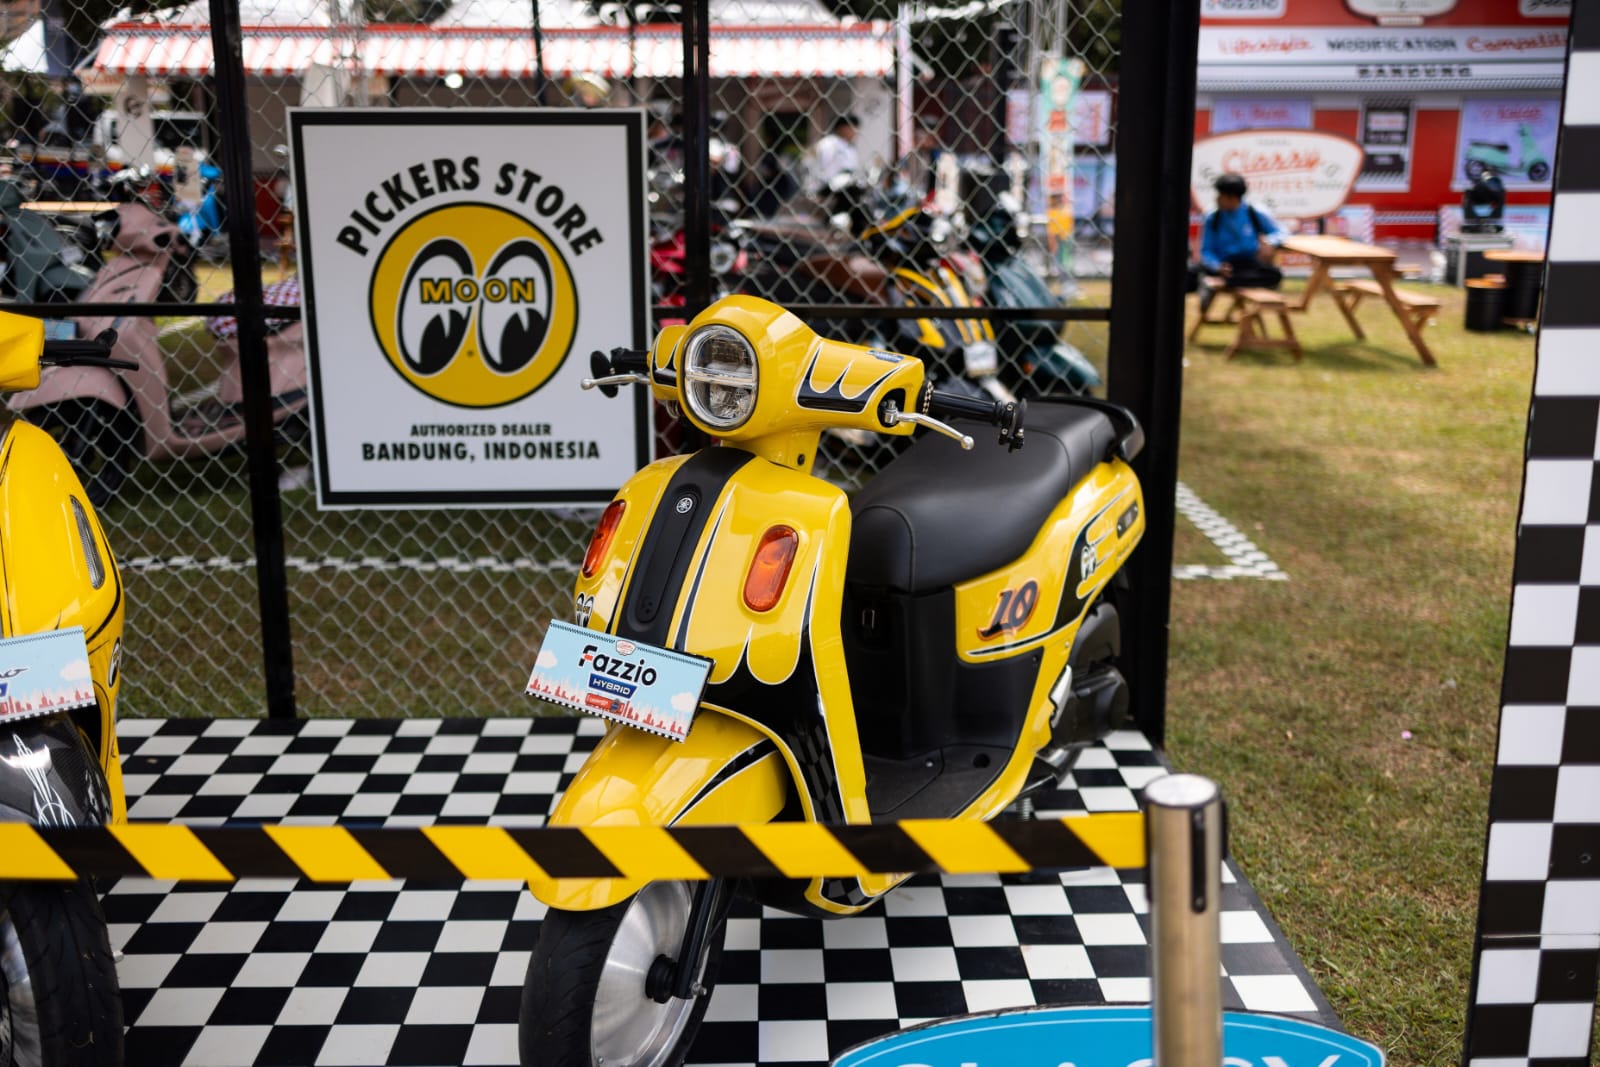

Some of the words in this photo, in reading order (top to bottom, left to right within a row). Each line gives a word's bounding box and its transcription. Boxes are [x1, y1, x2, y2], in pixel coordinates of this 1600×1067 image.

[1326, 38, 1457, 52] MODIFICATION
[1358, 65, 1472, 77] BANDUNG
[336, 156, 481, 257] PICKERS
[494, 162, 604, 256] STORE
[420, 277, 535, 304] MOON
[410, 424, 497, 437] AUTHORIZED
[501, 423, 552, 436] DEALER
[362, 443, 476, 463] BANDUNG,
[484, 441, 601, 460] INDONESIA
[578, 644, 657, 686] Fazzio
[592, 677, 631, 696] HYBRID
